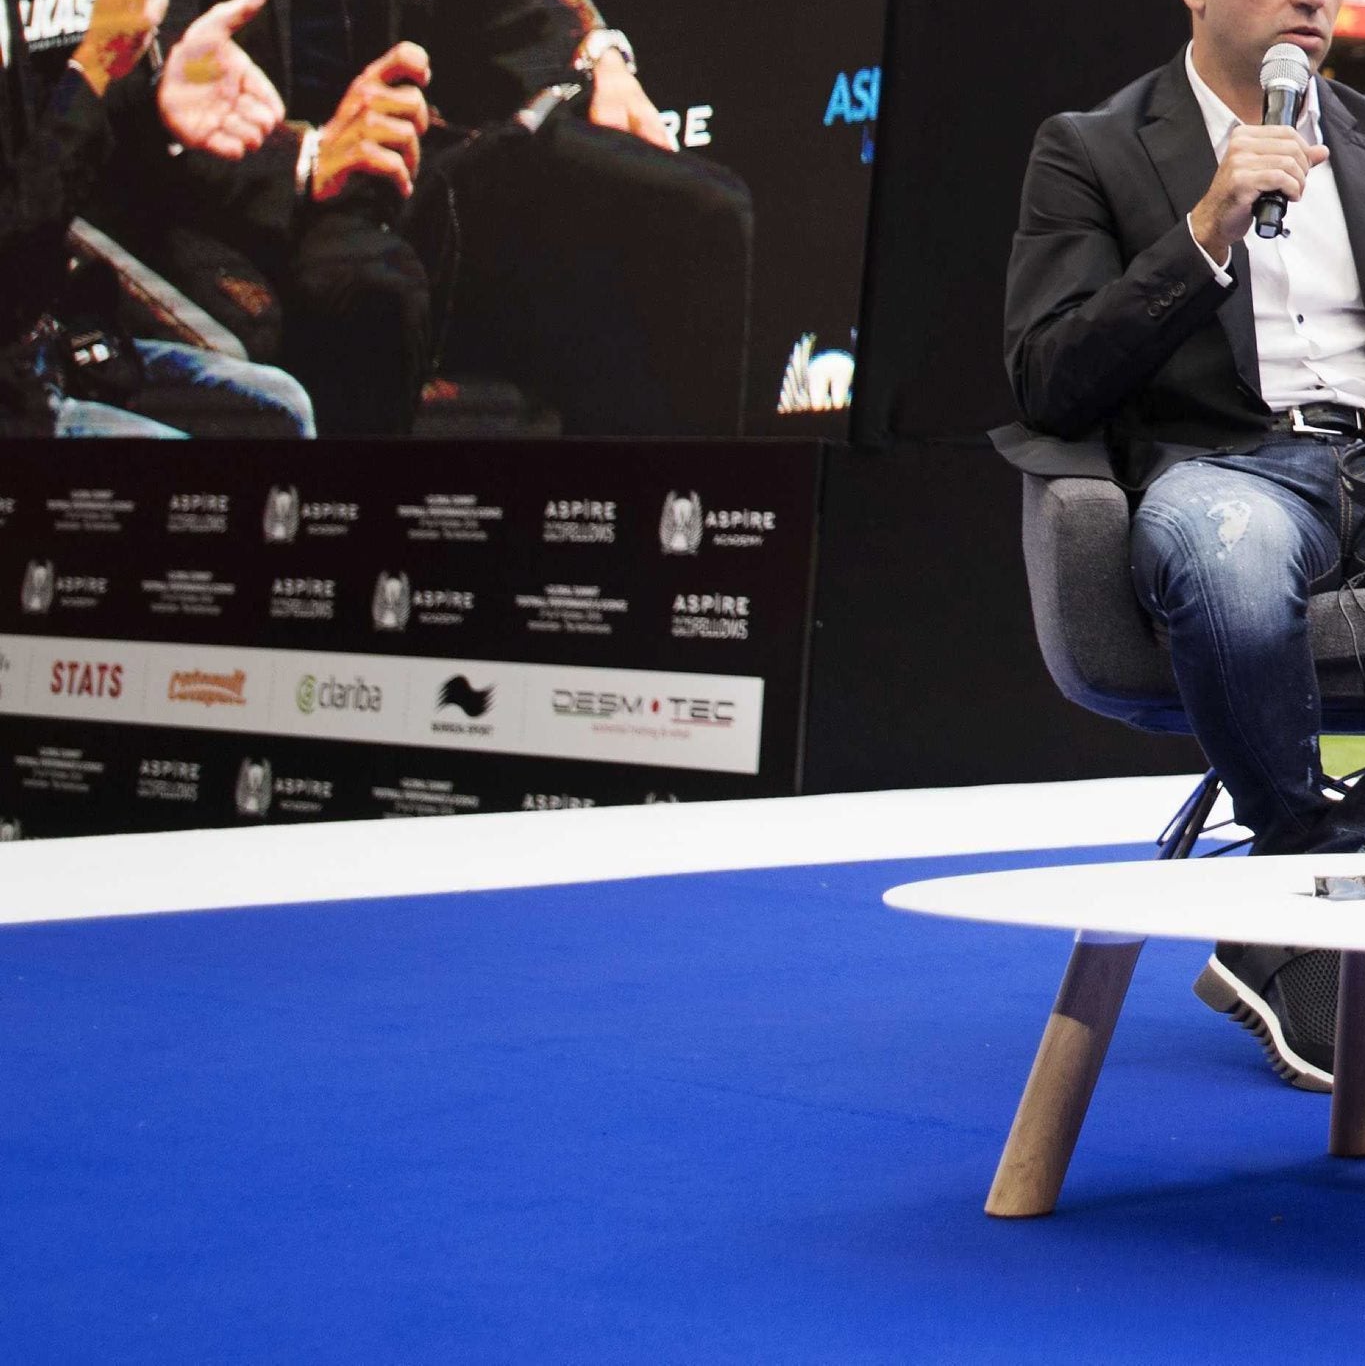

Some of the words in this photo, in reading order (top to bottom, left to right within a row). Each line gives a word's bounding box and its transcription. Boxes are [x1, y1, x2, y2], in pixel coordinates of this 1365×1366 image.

[170, 492, 229, 513] ASPIRE
[302, 501, 361, 523] ASPIRE
[544, 498, 617, 521] ASPIRE
[705, 508, 777, 532] ASPIRE
[272, 577, 336, 599] ASPIRE
[412, 589, 474, 611] ASPIRE
[673, 592, 750, 617] ASPIRE
[50, 660, 124, 699] STATS
[317, 675, 383, 713] clariba
